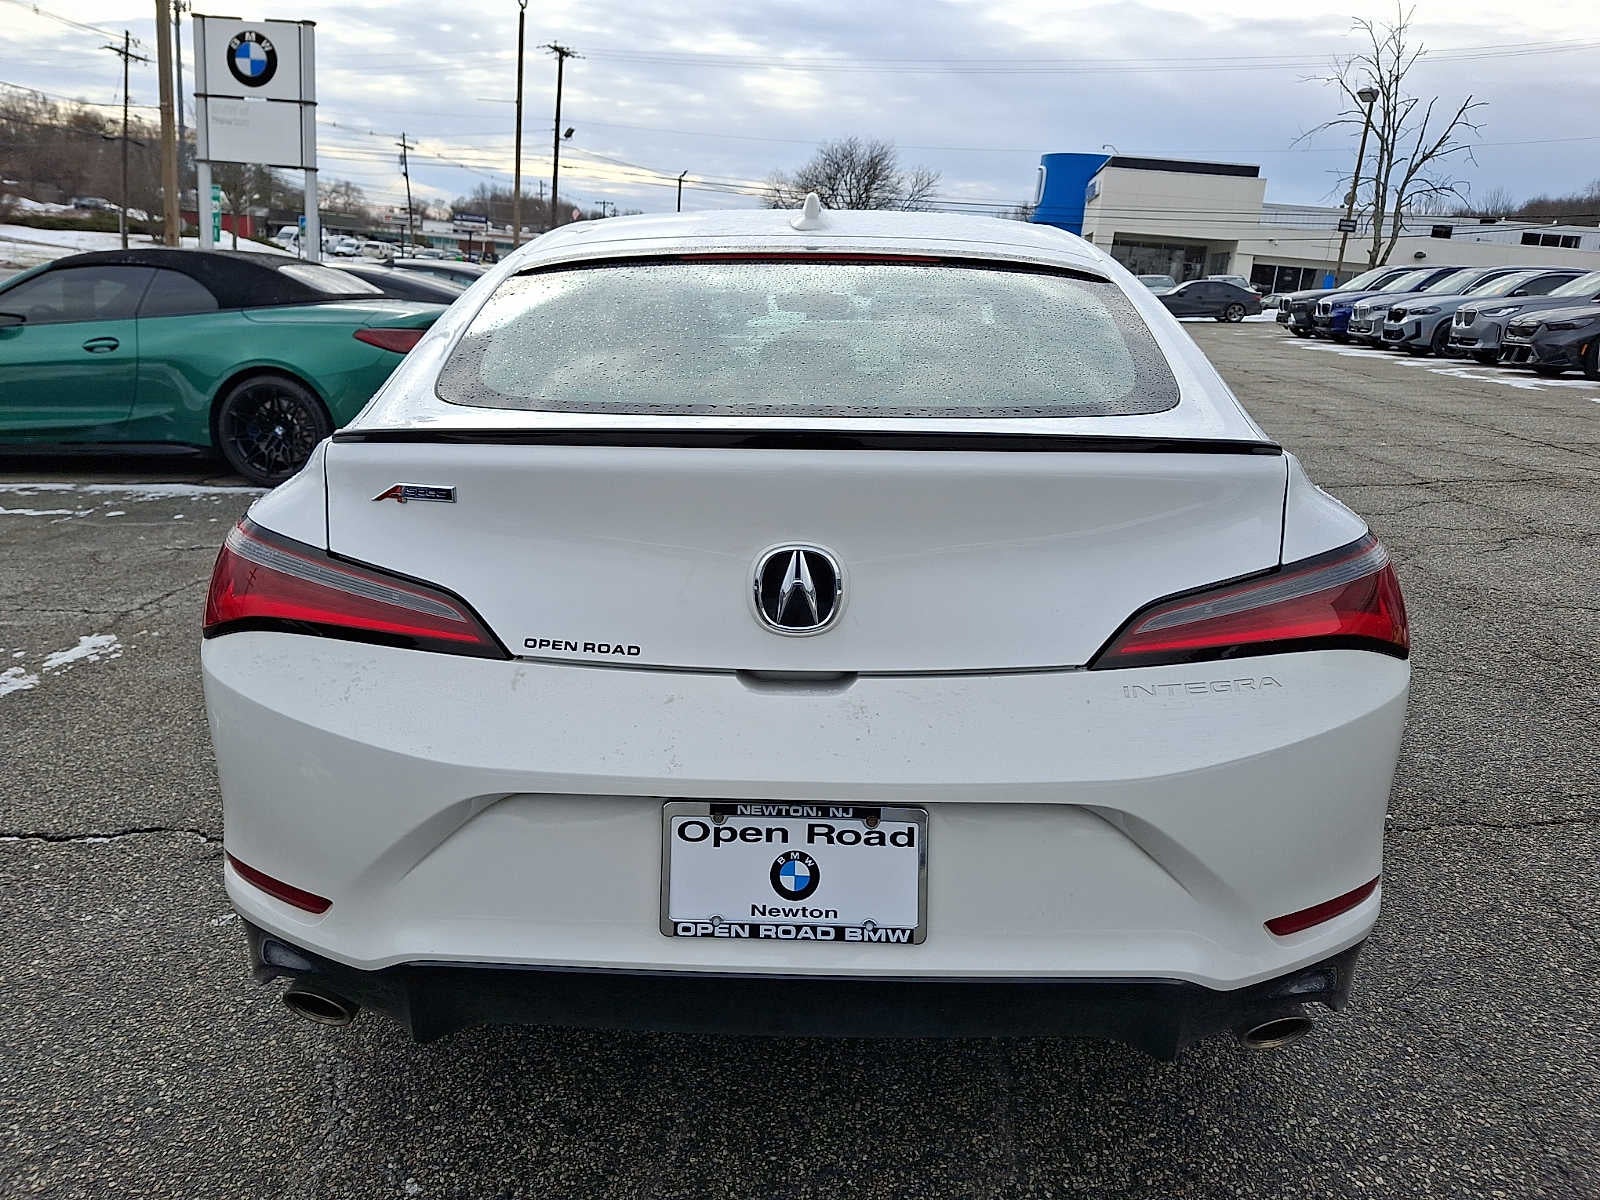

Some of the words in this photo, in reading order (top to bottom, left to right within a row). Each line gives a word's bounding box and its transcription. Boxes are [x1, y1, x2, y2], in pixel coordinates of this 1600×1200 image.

[230, 32, 273, 52] BMW
[524, 638, 578, 651] OPEN
[583, 642, 641, 656] ROAD
[1122, 676, 1283, 699] INTEGRA
[829, 807, 853, 818] NJ
[677, 820, 789, 848] Open
[806, 823, 915, 848] Road
[776, 851, 815, 867] BMW
[751, 903, 838, 919] Newton
[677, 922, 750, 938] OPEN
[759, 924, 836, 940] ROAD
[844, 927, 911, 943] BMW
